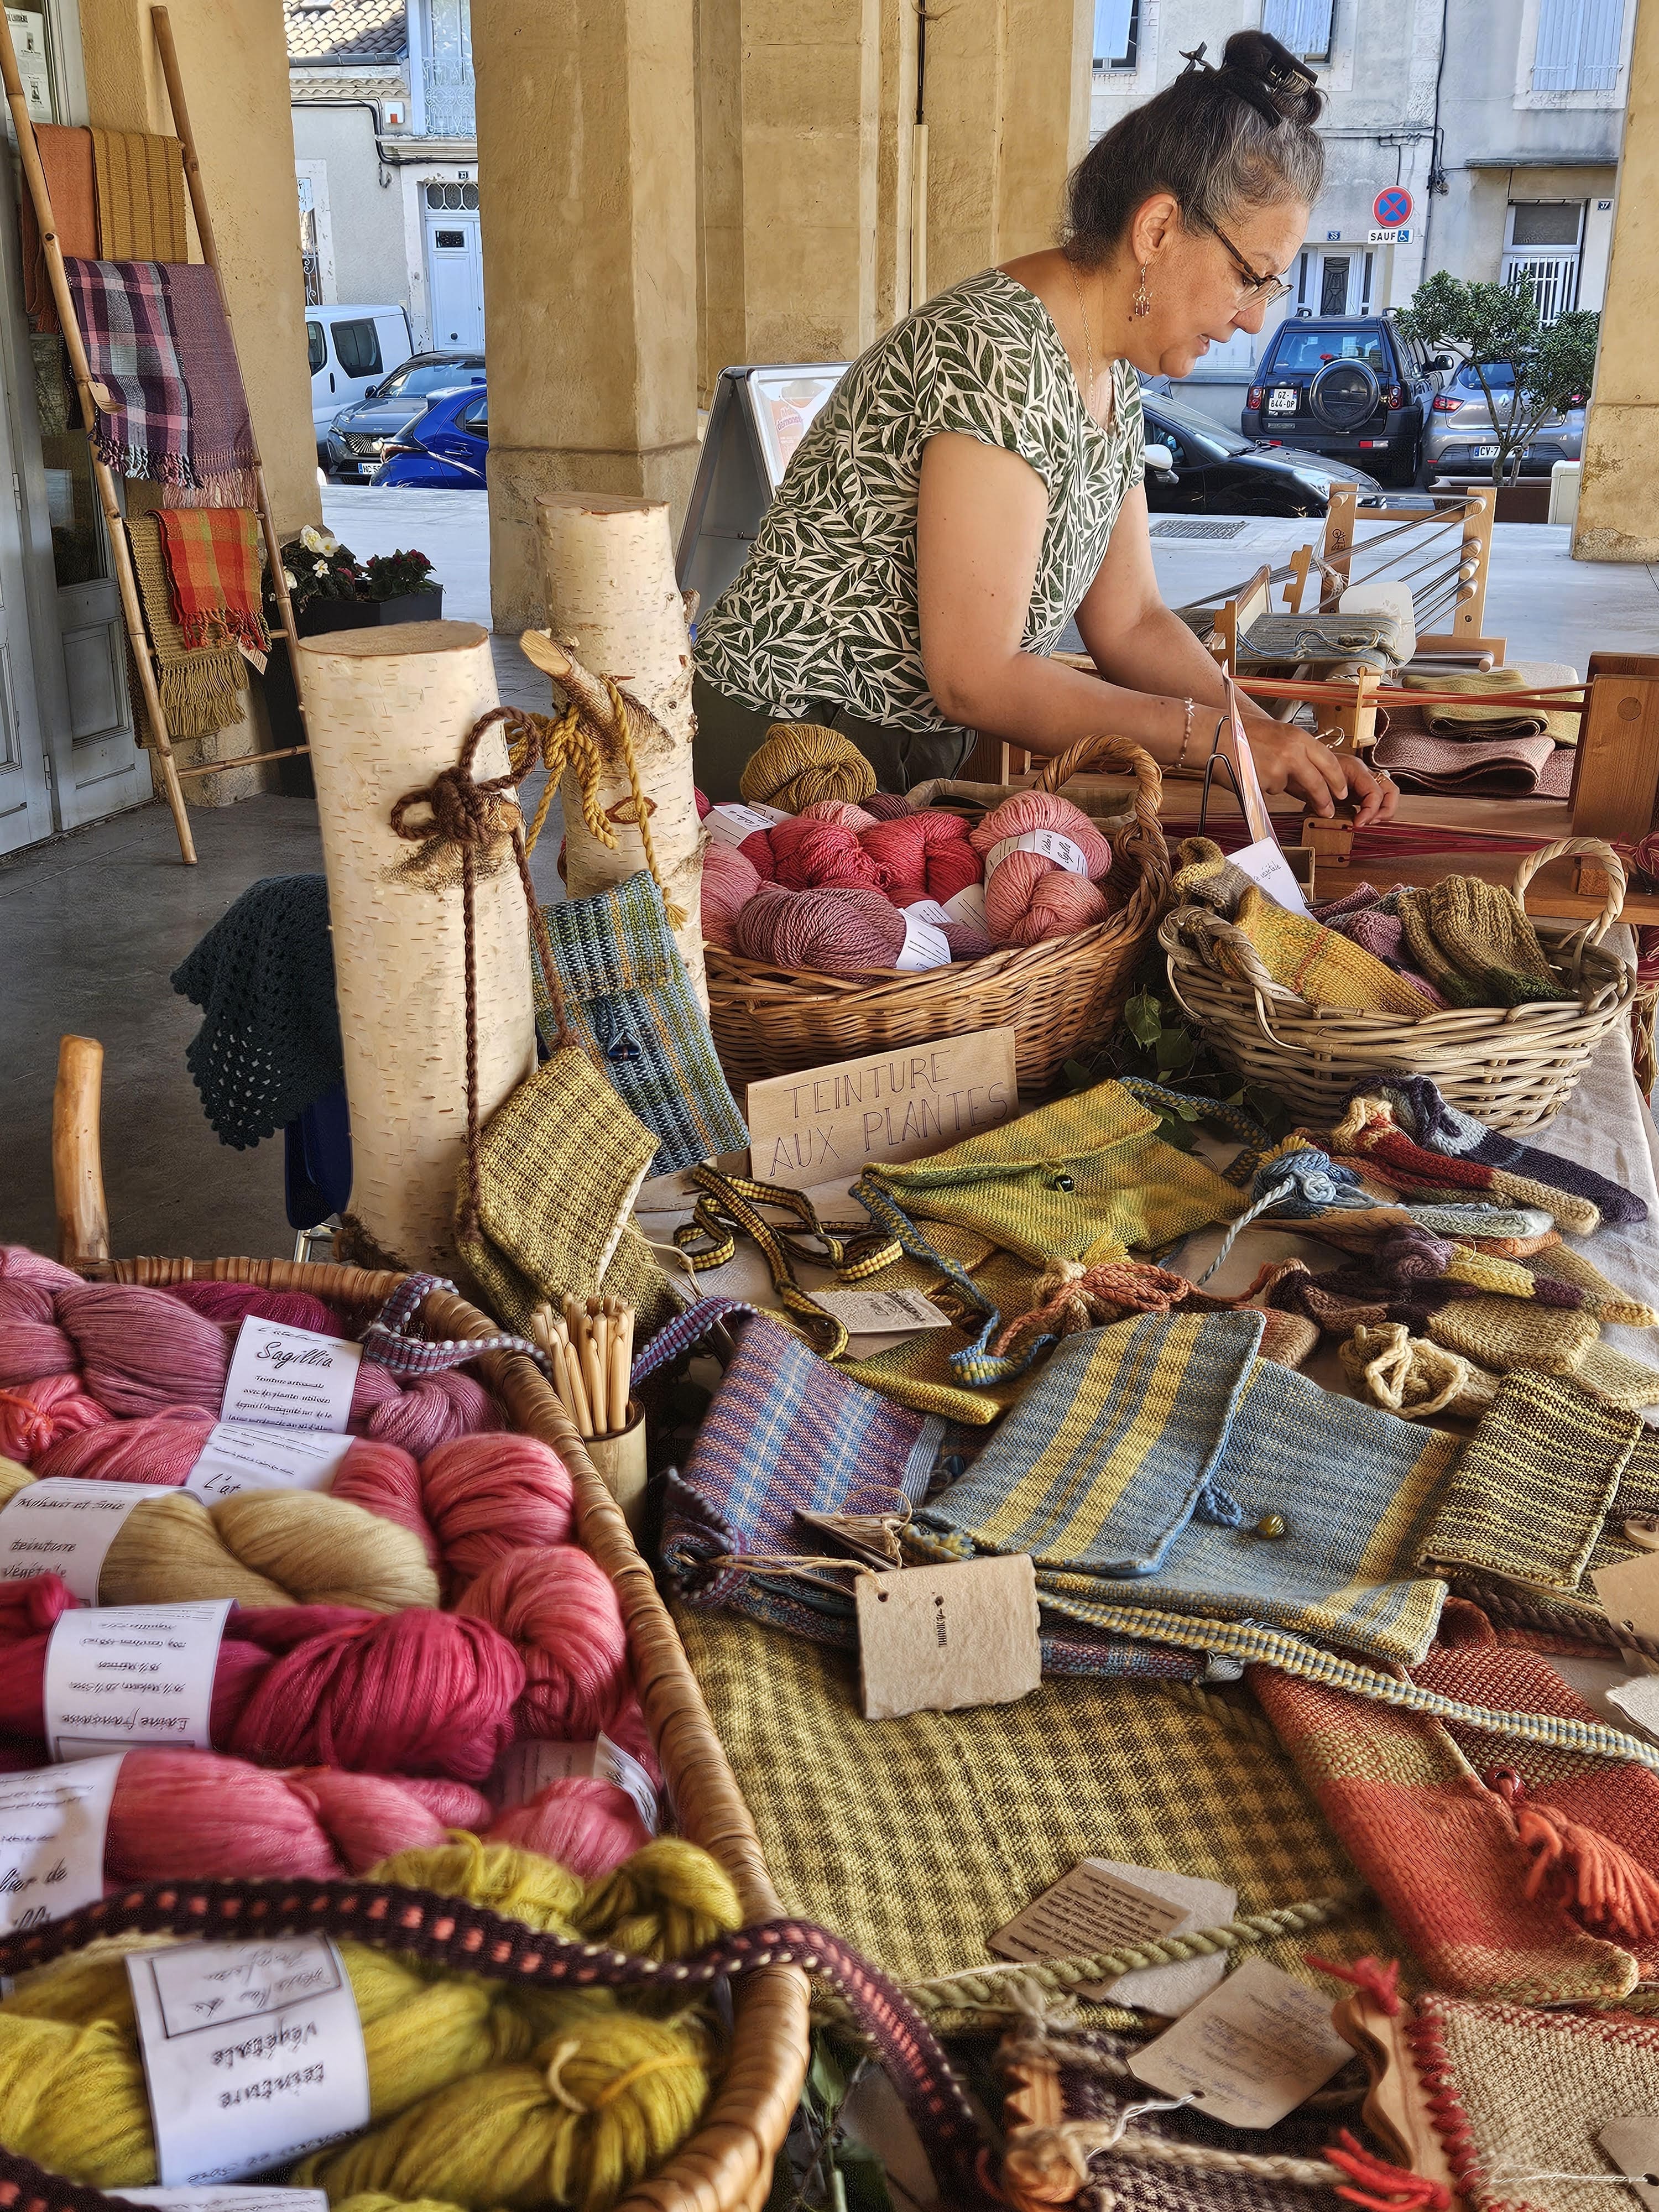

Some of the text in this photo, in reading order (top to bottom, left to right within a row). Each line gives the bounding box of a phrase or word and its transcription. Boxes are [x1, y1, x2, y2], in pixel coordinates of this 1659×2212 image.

[1370, 232, 1396, 241] SAUF
[783, 1050, 951, 1119] TEINTURE
[769, 1082, 1008, 1177] AUX PLANTES
[257, 1341, 333, 1369] Sagillia
[9, 1536, 77, 1552] teinture
[140, 1716, 190, 1733] Laine
